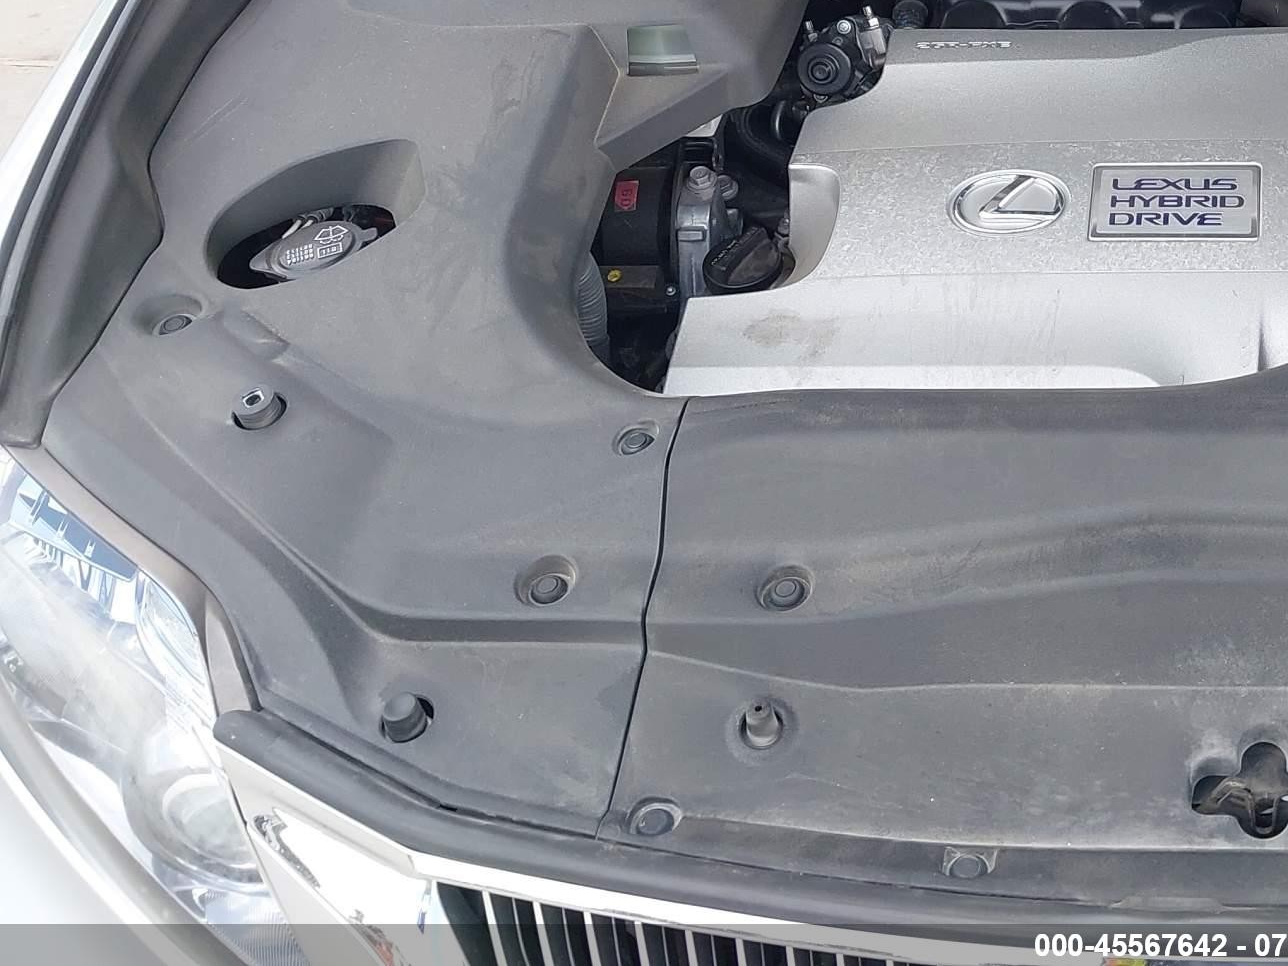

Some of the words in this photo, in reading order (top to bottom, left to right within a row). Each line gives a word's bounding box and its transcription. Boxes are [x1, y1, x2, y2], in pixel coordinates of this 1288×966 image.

[1112, 178, 1238, 191] LEXUS
[1110, 194, 1245, 208] HYBRID
[1108, 212, 1223, 226] DRIVE
